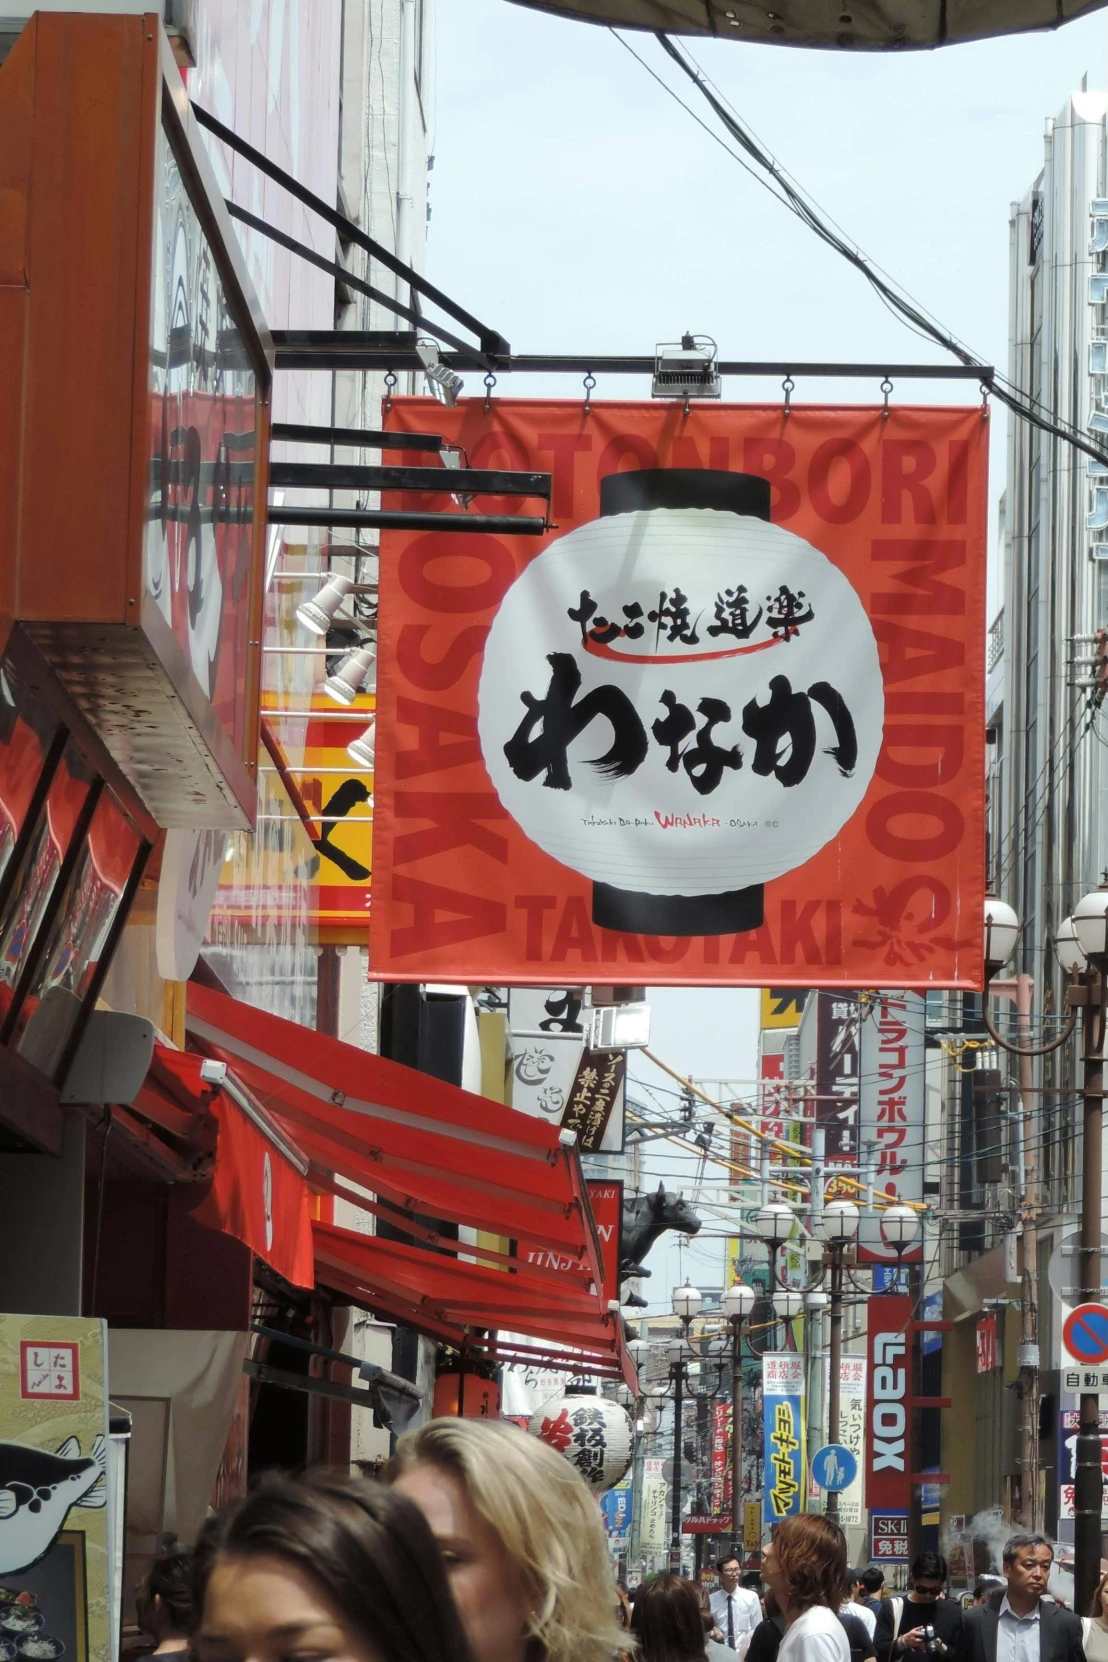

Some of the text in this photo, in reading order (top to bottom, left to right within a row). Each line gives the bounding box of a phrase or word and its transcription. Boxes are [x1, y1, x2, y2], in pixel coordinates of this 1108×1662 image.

[391, 534, 517, 958] OSAKA
[503, 651, 859, 795] わなか
[866, 538, 968, 862] MAIDO
[581, 1053, 624, 1148] ソースの二度漬けは
[770, 1401, 800, 1517] マツモトキヨシ
[878, 1541, 908, 1555] 免税
